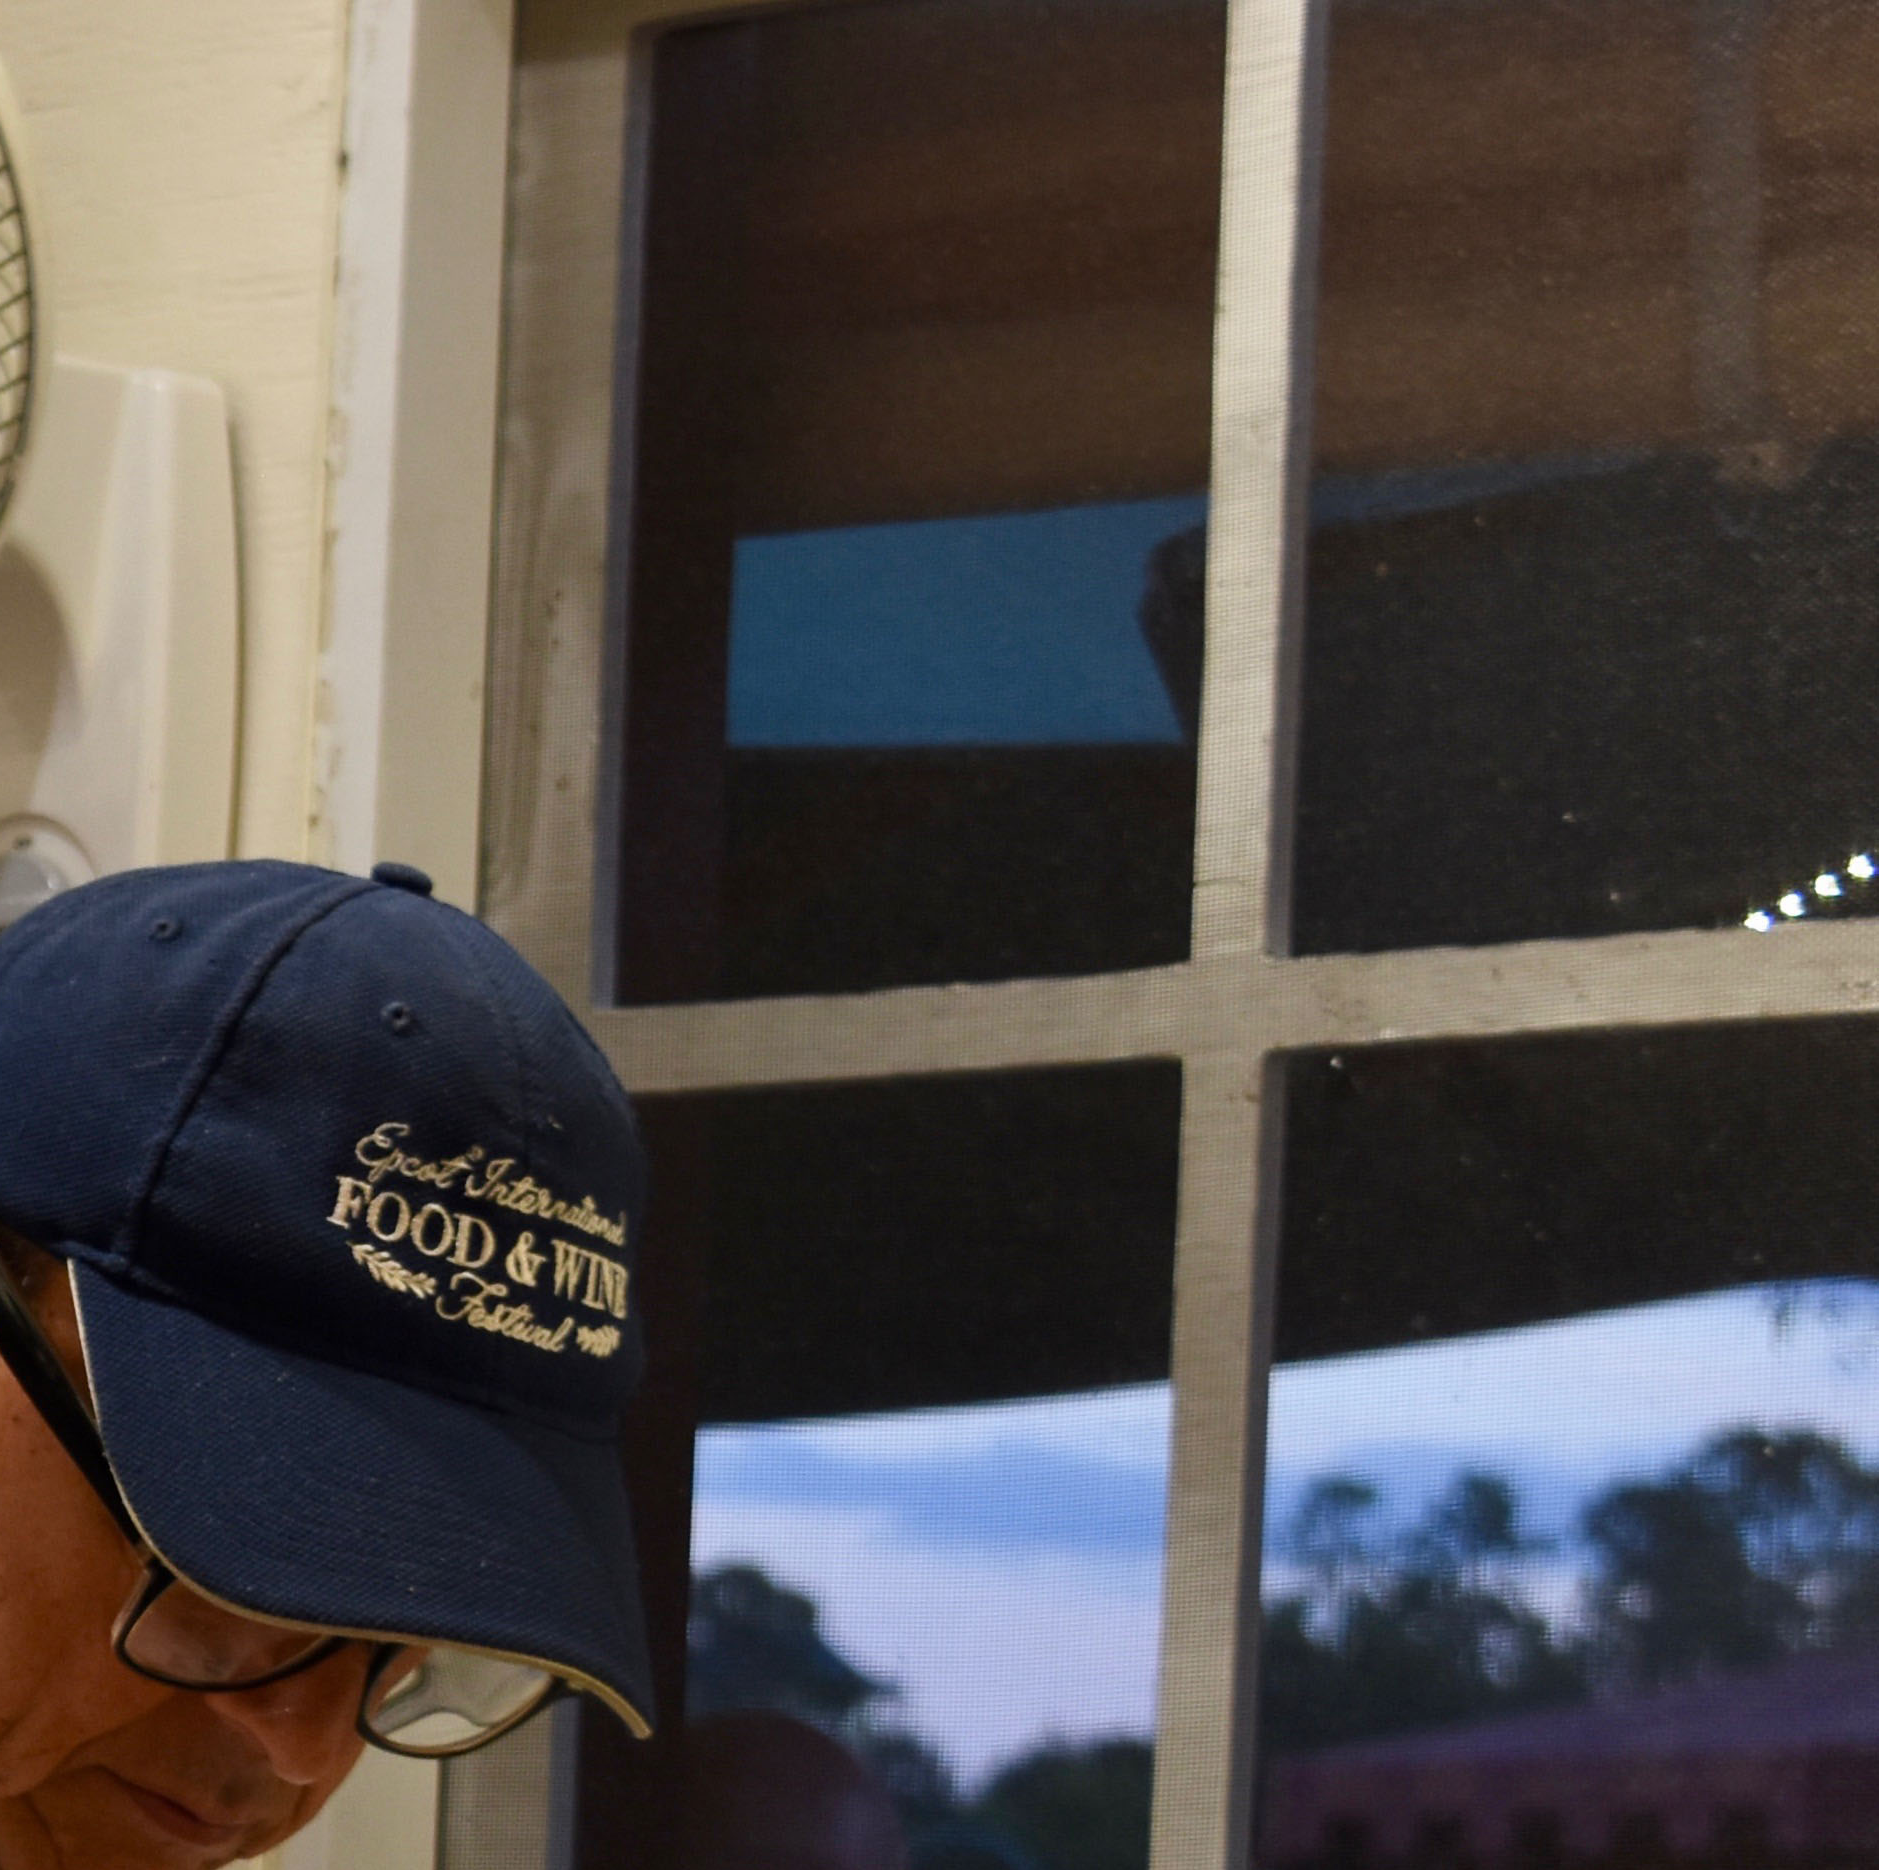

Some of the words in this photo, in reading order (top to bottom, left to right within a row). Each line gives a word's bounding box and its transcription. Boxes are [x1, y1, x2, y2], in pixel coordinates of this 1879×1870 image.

[326, 1174, 496, 1269] FOOD
[505, 1230, 546, 1288] &
[435, 1270, 574, 1353] Festival
